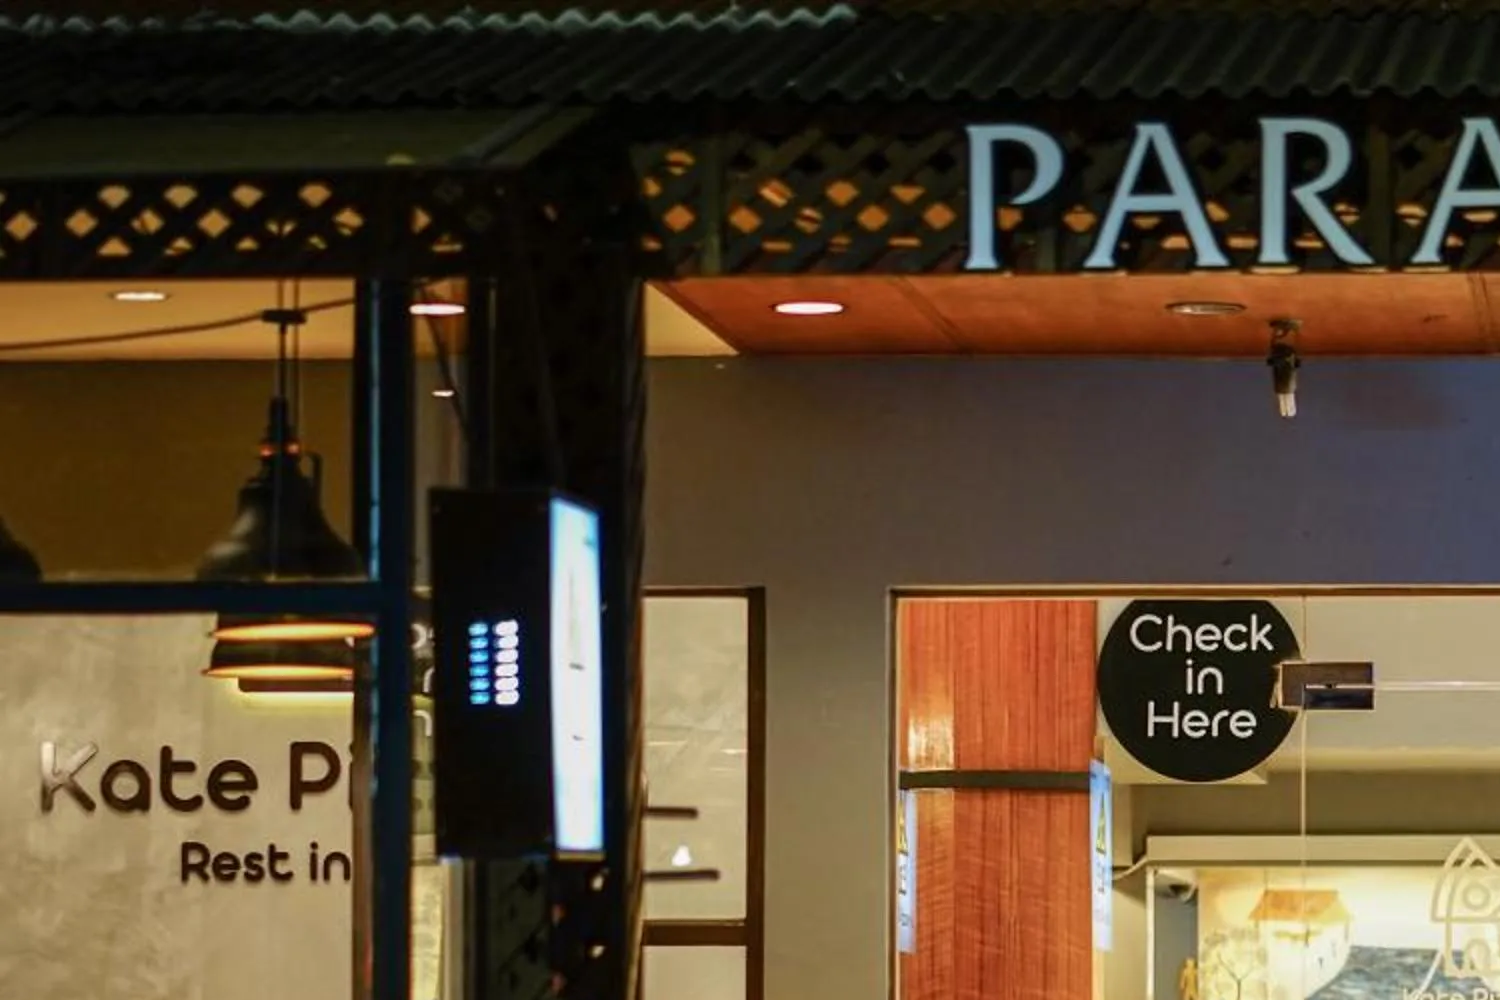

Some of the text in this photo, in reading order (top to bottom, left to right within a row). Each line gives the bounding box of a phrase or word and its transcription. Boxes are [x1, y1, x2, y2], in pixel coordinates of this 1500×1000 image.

[1130, 613, 1274, 652] Check
[1186, 658, 1224, 695] in
[1147, 701, 1257, 739] Here
[40, 741, 259, 814] Kate
[181, 841, 294, 884] Rest
